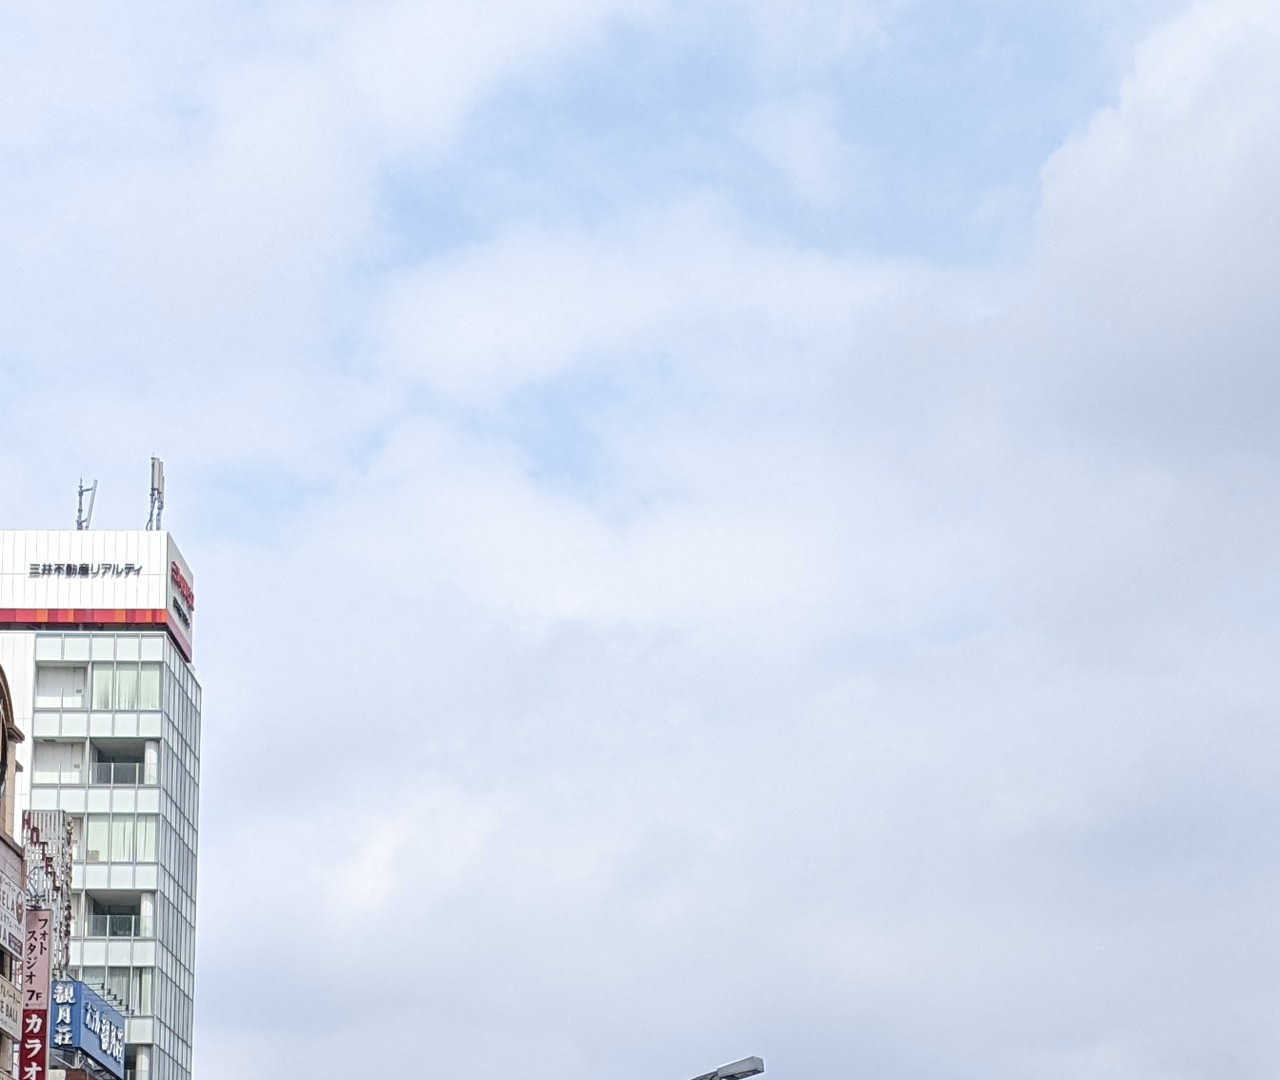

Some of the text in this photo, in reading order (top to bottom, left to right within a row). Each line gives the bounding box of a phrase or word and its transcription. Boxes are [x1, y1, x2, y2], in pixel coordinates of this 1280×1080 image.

[29, 563, 142, 578] 三井不動産リアルティ
[23, 811, 60, 892] HOTEL
[38, 918, 48, 956] フォト
[25, 930, 37, 985] スタジオ
[26, 989, 43, 1001] 7F
